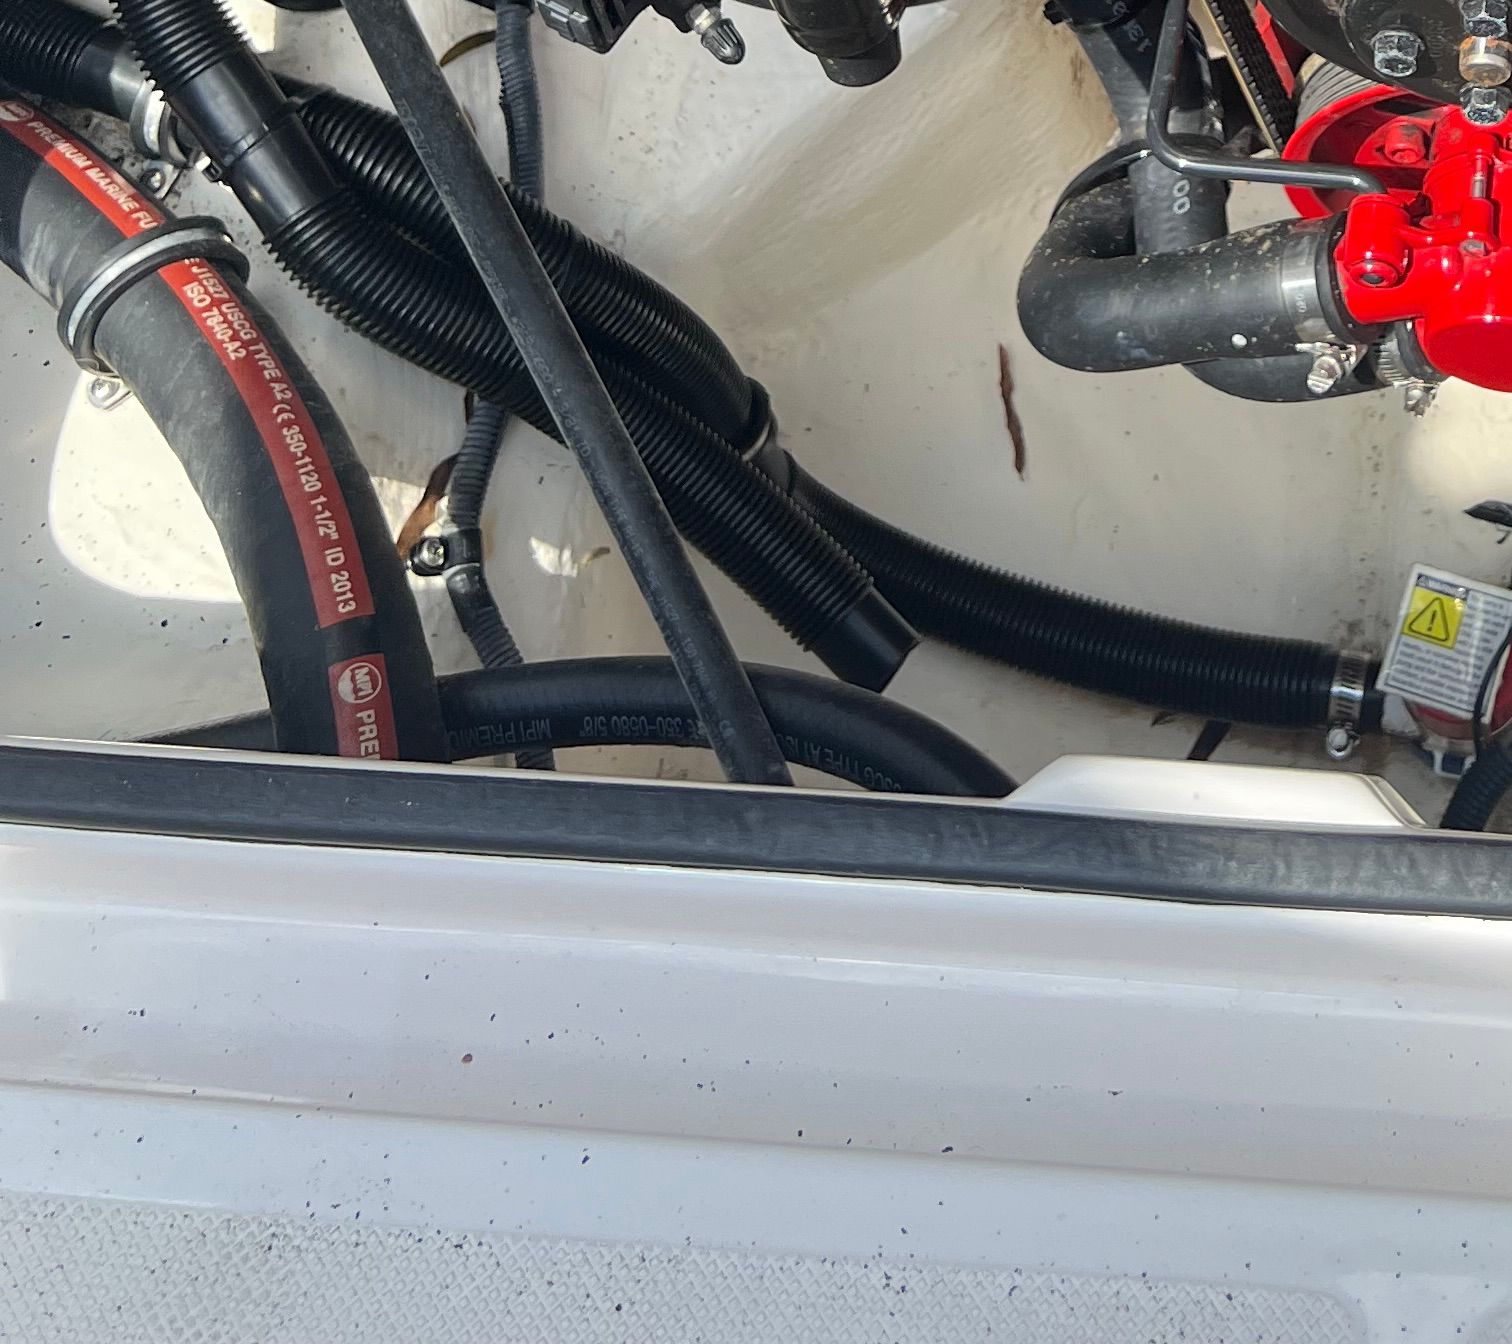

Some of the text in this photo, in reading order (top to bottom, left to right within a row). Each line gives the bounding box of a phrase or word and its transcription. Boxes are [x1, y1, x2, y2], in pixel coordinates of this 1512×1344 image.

[27, 121, 159, 231] PREMIUM MARINE FU
[181, 279, 212, 311] ISO
[219, 298, 258, 342] USCG
[248, 339, 283, 383] TYPE
[269, 378, 293, 404] A2
[281, 424, 323, 493] 350-1120
[323, 546, 346, 568] ID
[328, 569, 358, 615] 2013
[355, 708, 381, 759] PRE
[446, 721, 515, 750] PREMIU
